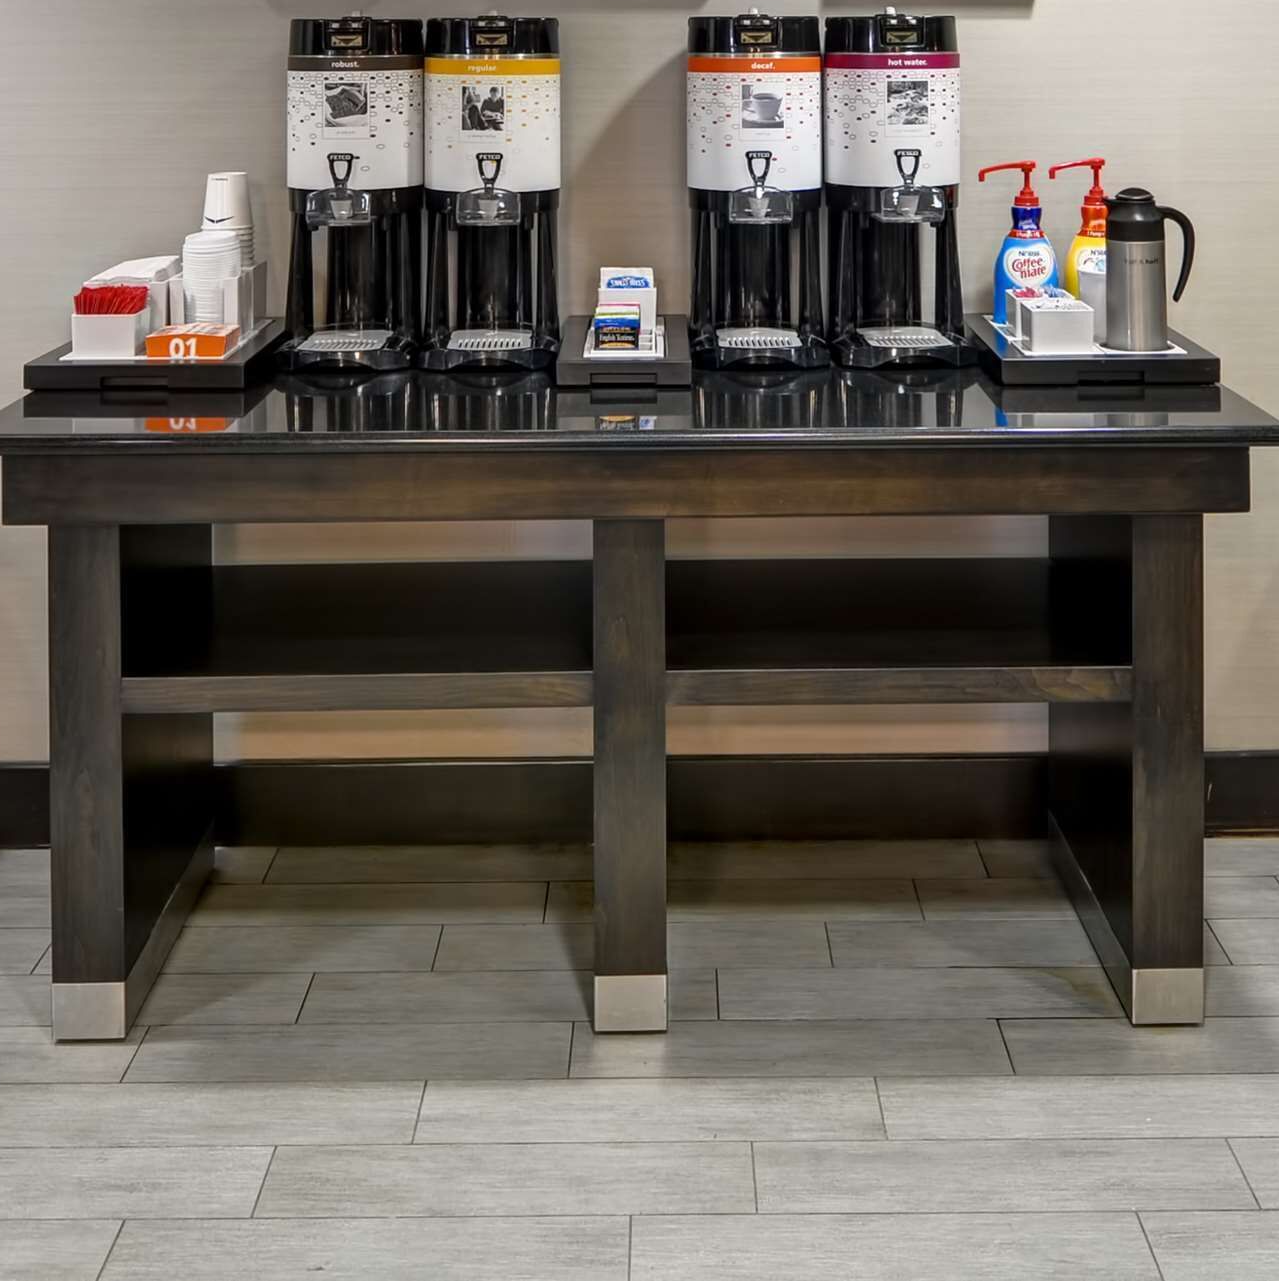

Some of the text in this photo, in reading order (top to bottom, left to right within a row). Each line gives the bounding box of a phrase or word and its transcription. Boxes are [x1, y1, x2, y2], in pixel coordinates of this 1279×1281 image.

[751, 62, 776, 70] decaf.
[888, 58, 902, 66] hot
[1012, 257, 1043, 272] Coffee
[1020, 265, 1046, 279] mate
[169, 337, 197, 357] 01
